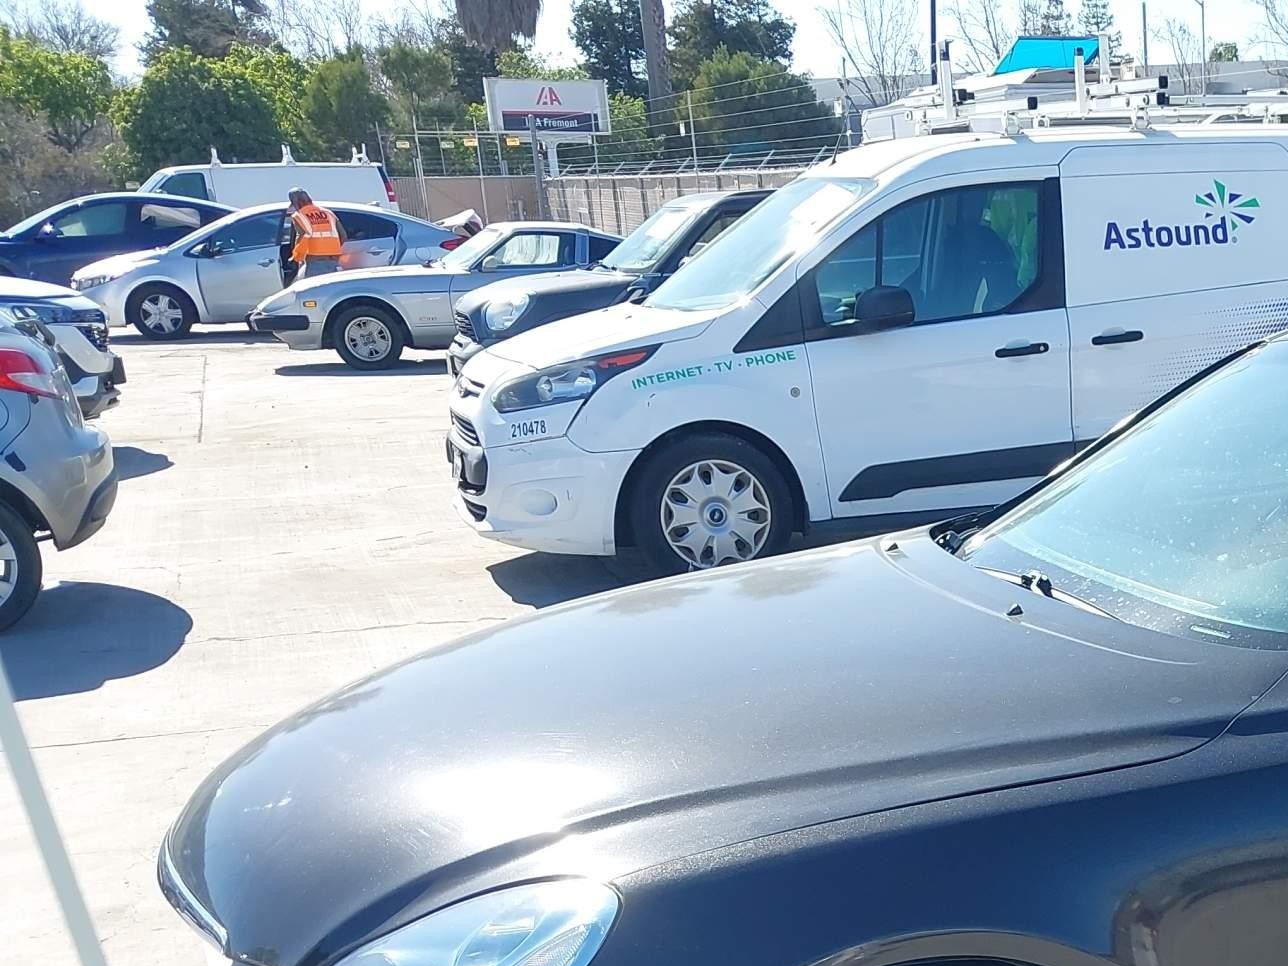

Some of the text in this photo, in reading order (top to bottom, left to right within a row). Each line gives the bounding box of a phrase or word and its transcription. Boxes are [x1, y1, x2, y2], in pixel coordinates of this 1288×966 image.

[543, 118, 578, 127] Fremont
[1103, 215, 1229, 251] Astound
[631, 350, 797, 390] INTERNET TV PHONE
[511, 419, 547, 438] 210478
